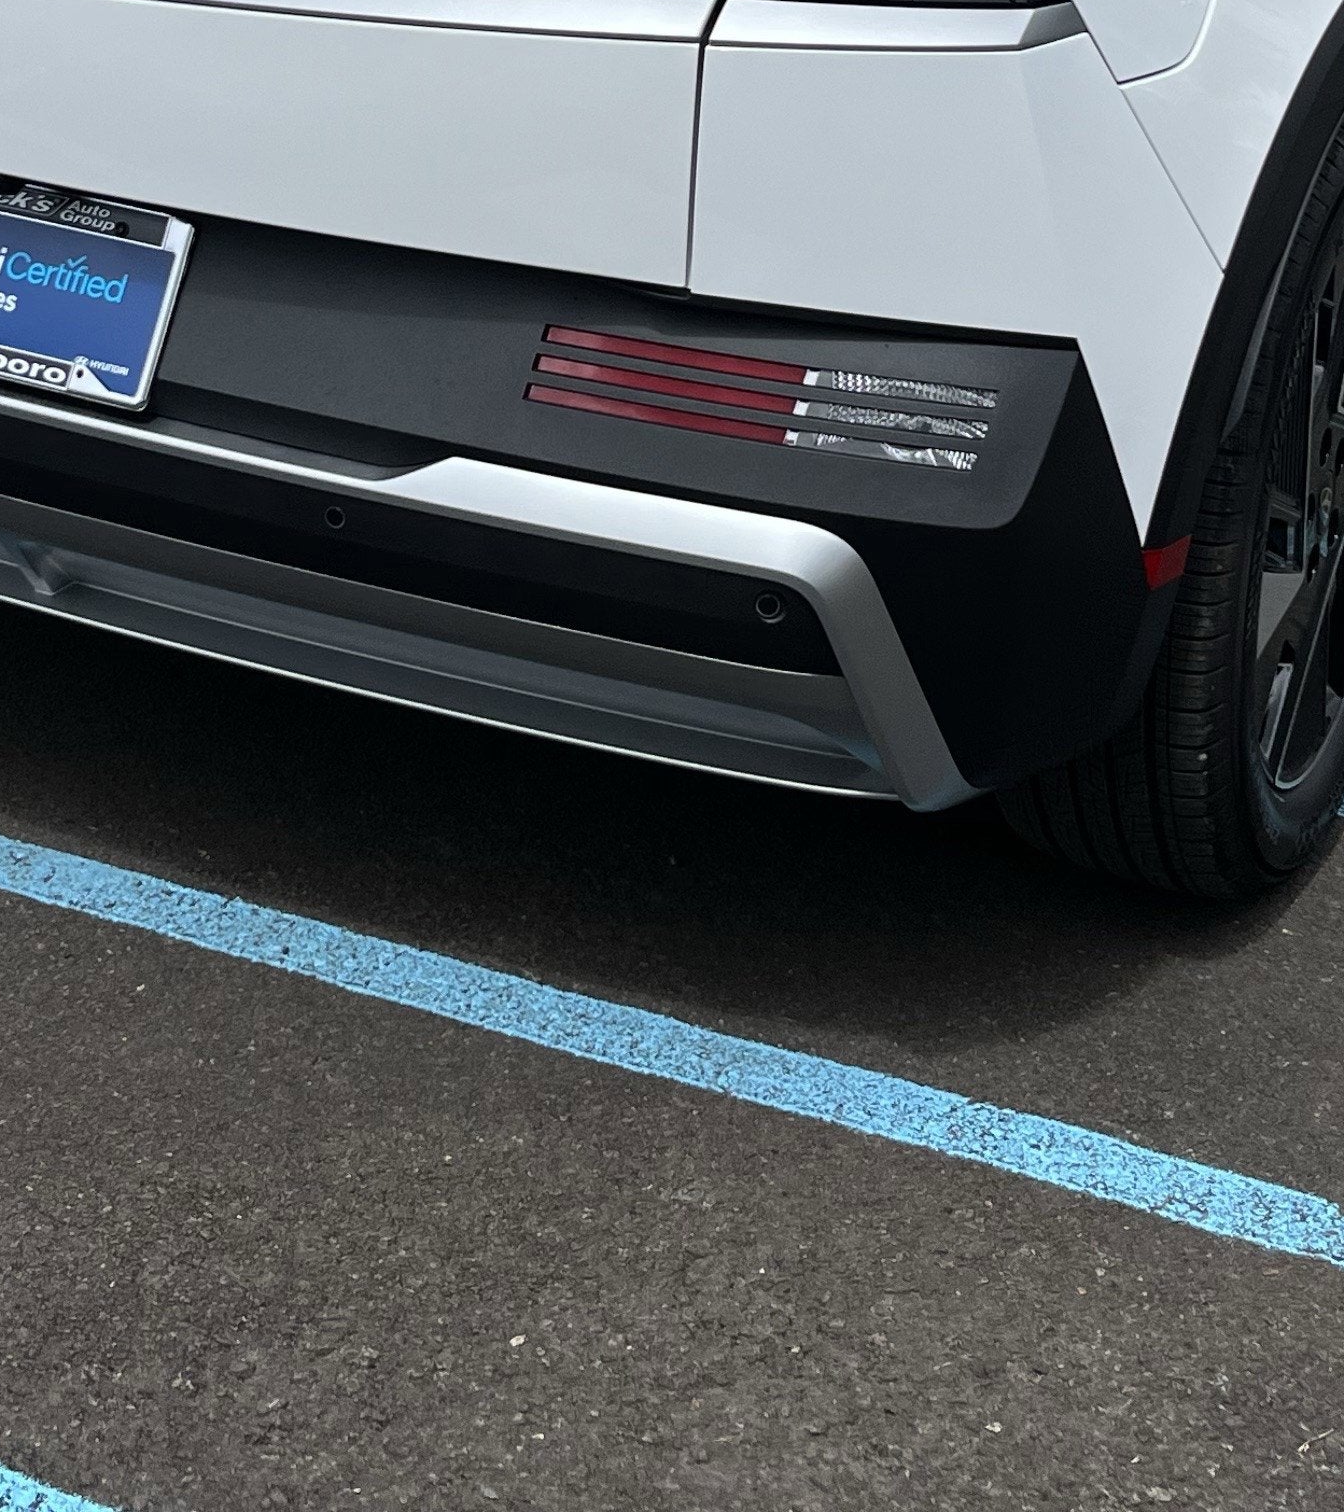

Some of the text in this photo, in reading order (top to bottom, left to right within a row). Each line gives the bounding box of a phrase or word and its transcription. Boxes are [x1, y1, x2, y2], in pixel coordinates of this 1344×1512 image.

[59, 208, 116, 232] Group
[67, 199, 111, 219] Auto
[6, 251, 129, 304] Certified
[89, 359, 129, 376] HYUNDAI
